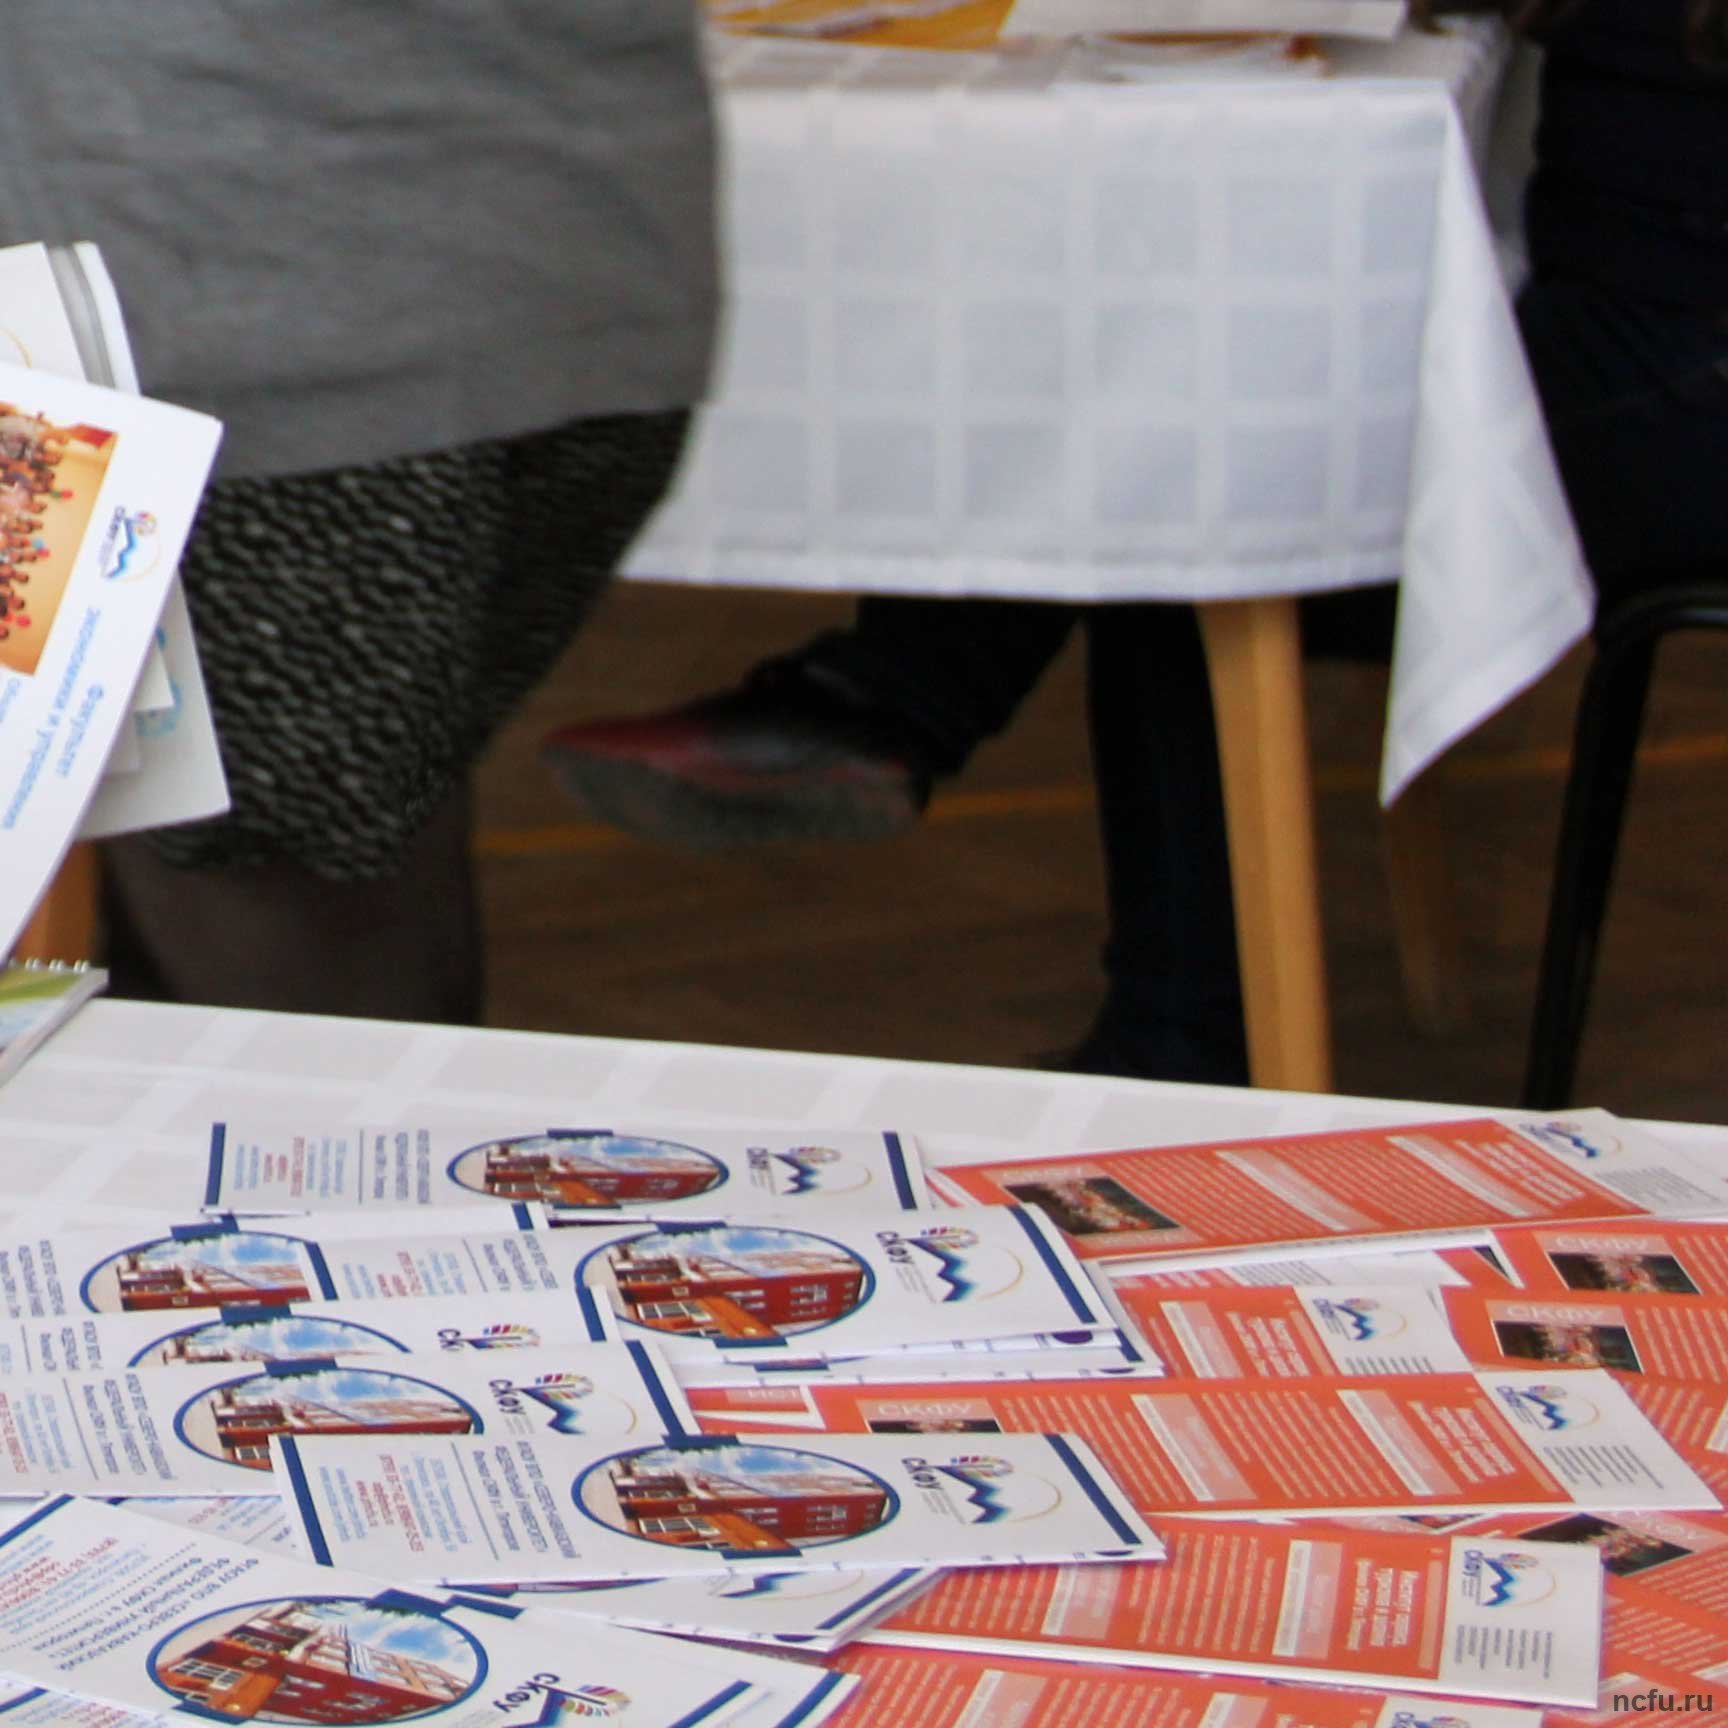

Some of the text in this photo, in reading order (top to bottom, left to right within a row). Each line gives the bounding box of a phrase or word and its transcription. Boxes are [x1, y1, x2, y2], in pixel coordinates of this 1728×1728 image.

[52, 607, 101, 710] экономики
[55, 685, 104, 777] Факультет
[2, 727, 52, 829] управления
[875, 1230, 915, 1265] СКФУ
[1554, 1236, 1649, 1251] СКФУ
[1505, 1305, 1607, 1320] СКФУ
[488, 1379, 528, 1415] СКФУ
[876, 1403, 974, 1417] СКФУ
[900, 1456, 944, 1491] СКФУ
[492, 1672, 561, 1714] СКФУ
